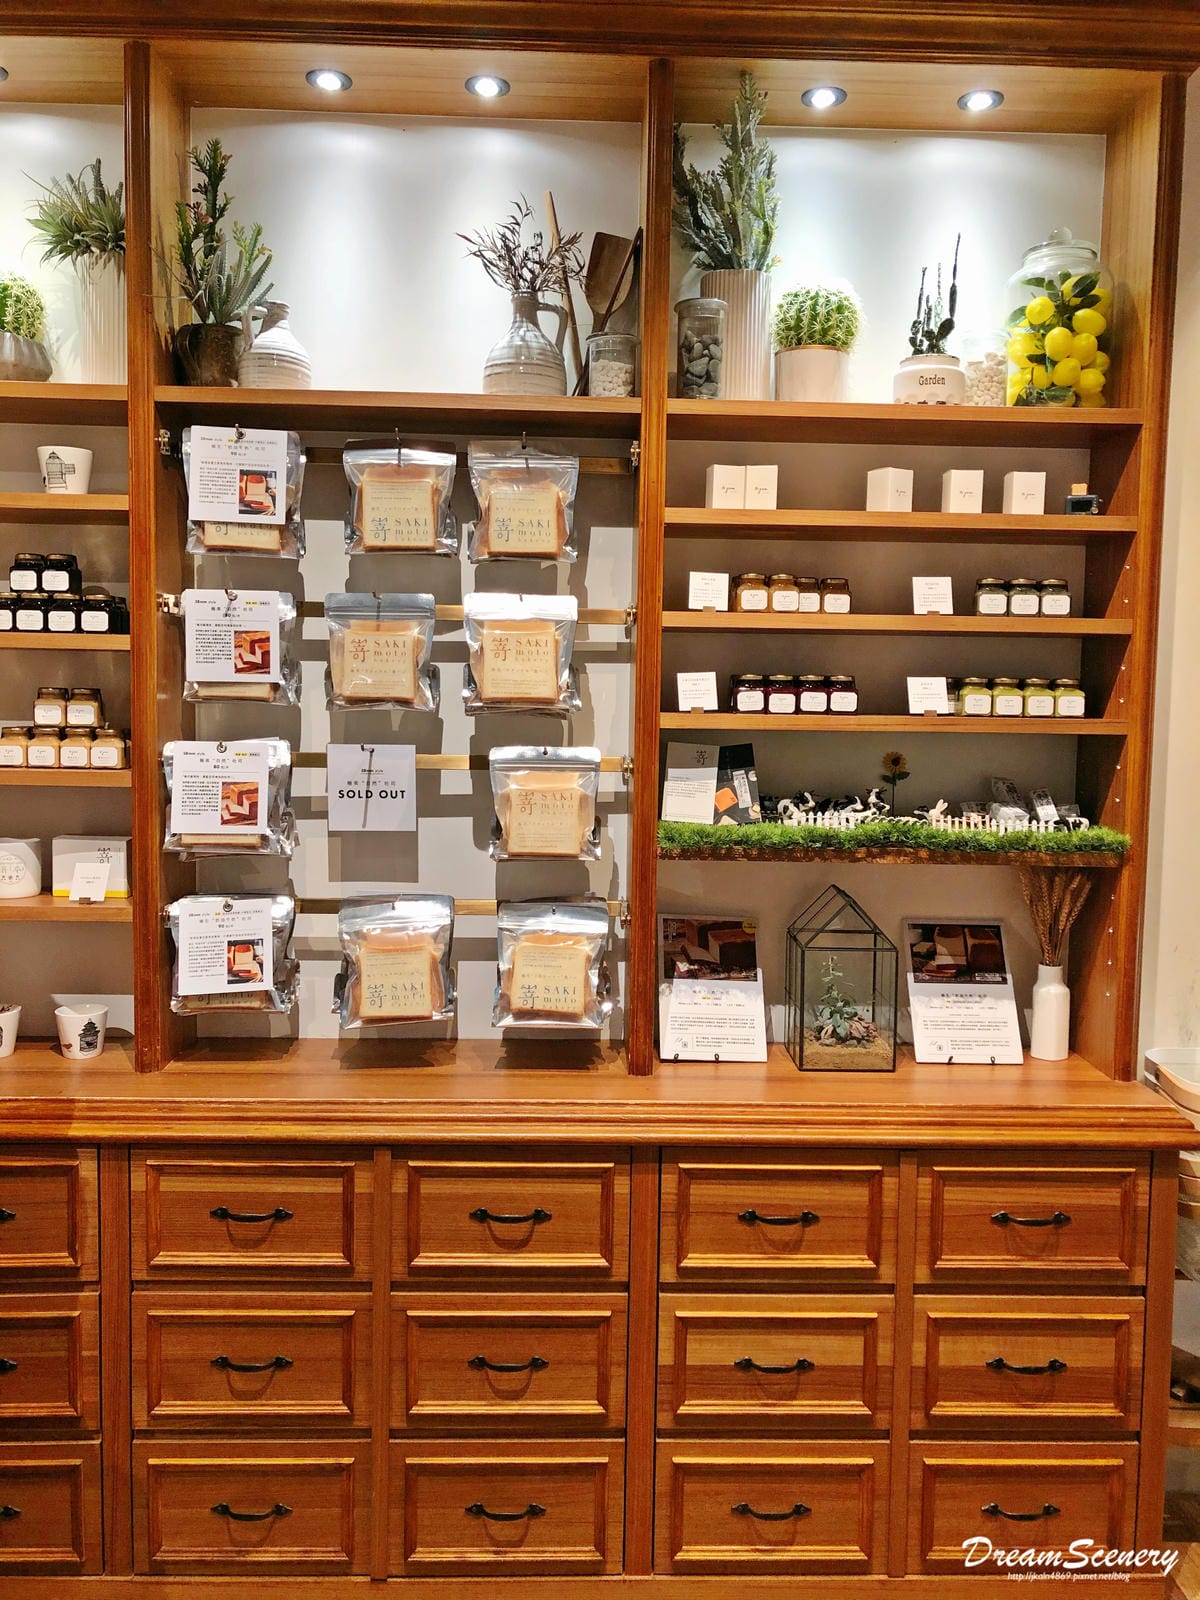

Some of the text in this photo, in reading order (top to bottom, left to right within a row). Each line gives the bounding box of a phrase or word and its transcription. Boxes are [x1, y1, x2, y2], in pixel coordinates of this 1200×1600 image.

[919, 374, 946, 386] Garden
[394, 518, 427, 527] SAKI
[518, 519, 551, 529] SAKI
[374, 640, 407, 649] SAKI
[515, 639, 549, 648] SAKI
[338, 789, 406, 799] SOLD OUT
[541, 792, 573, 801] SAKI
[391, 981, 424, 992] SAKI
[543, 985, 576, 996] SAKI
[391, 992, 425, 1001] moto
